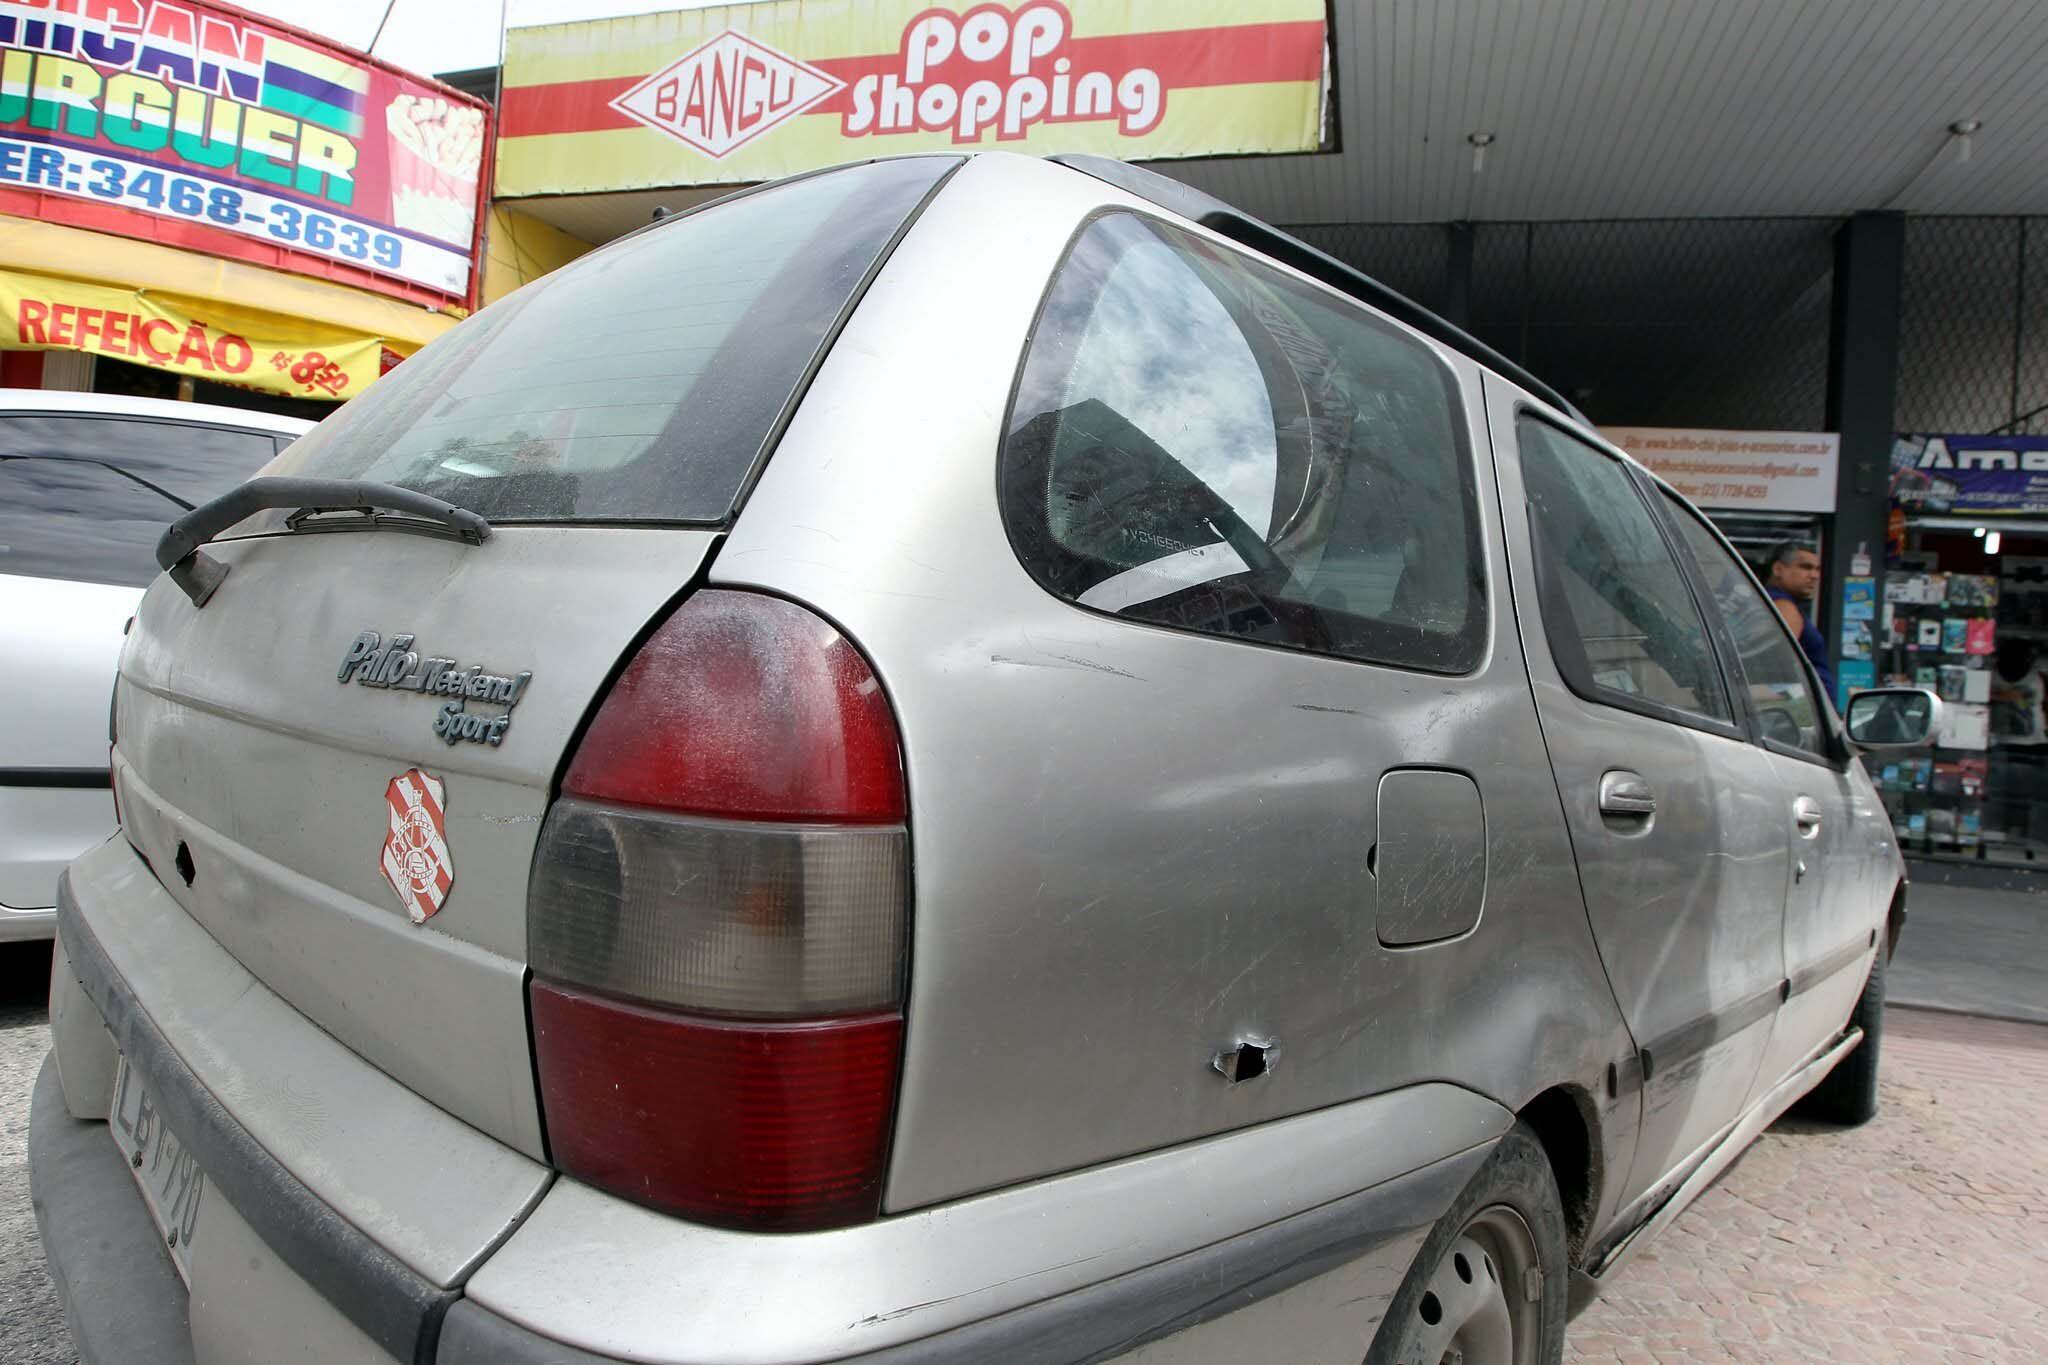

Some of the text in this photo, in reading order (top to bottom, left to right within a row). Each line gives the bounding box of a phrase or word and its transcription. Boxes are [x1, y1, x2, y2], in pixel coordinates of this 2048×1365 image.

[905, 6, 1066, 85] pop
[655, 47, 796, 142] BANGU
[18, 298, 254, 376] REFEIÇÃO
[337, 631, 533, 703] Palio Weekend
[432, 701, 512, 746] Sport
